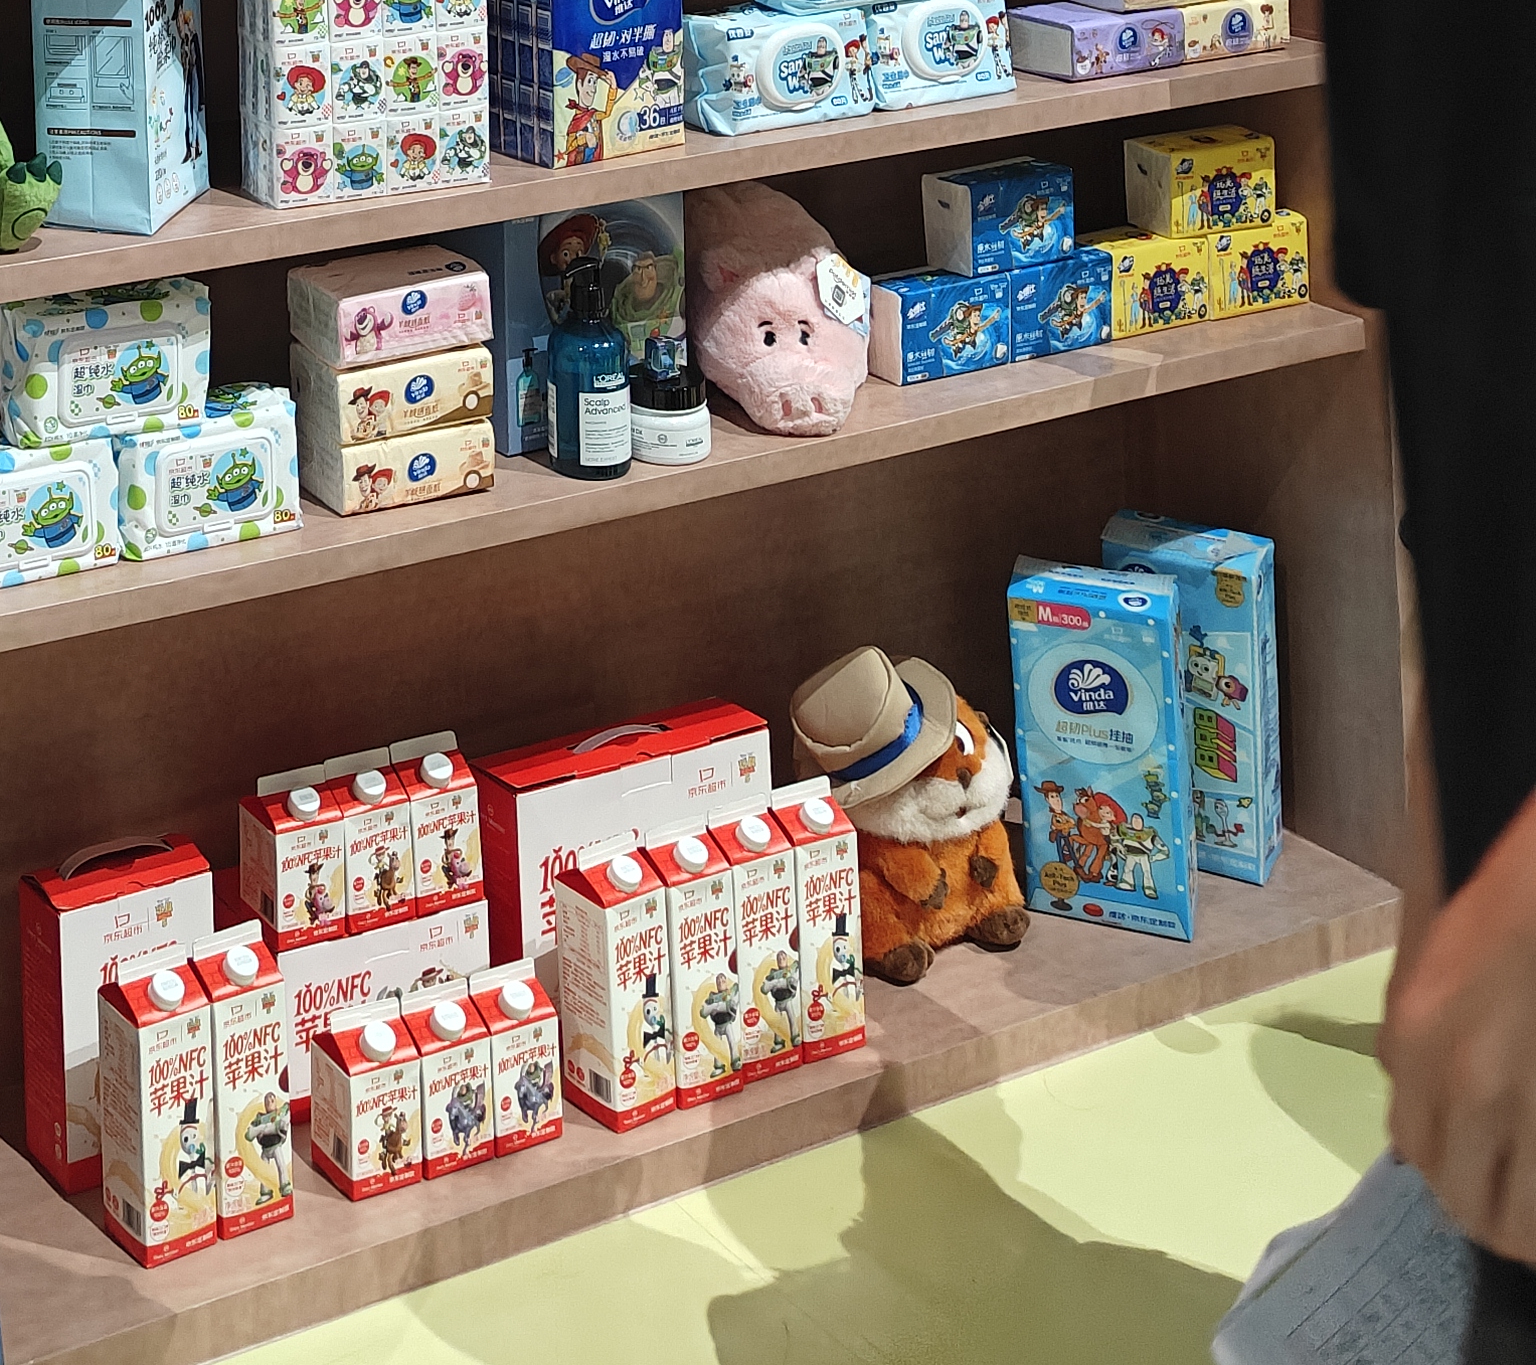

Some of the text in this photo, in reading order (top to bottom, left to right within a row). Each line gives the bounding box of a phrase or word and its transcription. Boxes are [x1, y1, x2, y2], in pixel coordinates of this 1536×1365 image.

[73, 362, 114, 380] 超纯水
[73, 383, 93, 395] 湿巾
[583, 397, 610, 409] Scalp
[584, 403, 627, 416] Advanced
[170, 471, 210, 490] 超纯水
[170, 493, 192, 507] 湿巾
[1069, 688, 1114, 702] Vinda
[687, 779, 727, 799] 京东超市
[349, 826, 408, 857] 100%NFC苹果汁
[417, 811, 476, 840] 100%NFC苹果汁
[281, 845, 342, 873] 100%NFC苹果汁
[804, 867, 854, 898] 100%NFC
[740, 885, 791, 921] 100%NFC
[805, 888, 856, 927] 苹果汁
[678, 906, 730, 943] 100%NFC
[742, 910, 794, 948] 苹果汁
[614, 924, 663, 959] 100%NFC
[680, 929, 732, 971] 苹果汁
[616, 946, 666, 991] 苹果汁
[293, 970, 372, 1017] 100%NFC
[222, 1021, 281, 1063] 100%NFC
[148, 1045, 206, 1087] 100%NFC
[224, 1045, 284, 1091] 苹果汁
[497, 1044, 557, 1075] 100%NFC苹果汁
[150, 1069, 210, 1117] 苹果汁
[428, 1063, 489, 1098] 100%NFC苹果汁
[356, 1085, 418, 1118] 100%NFC苹果汁
